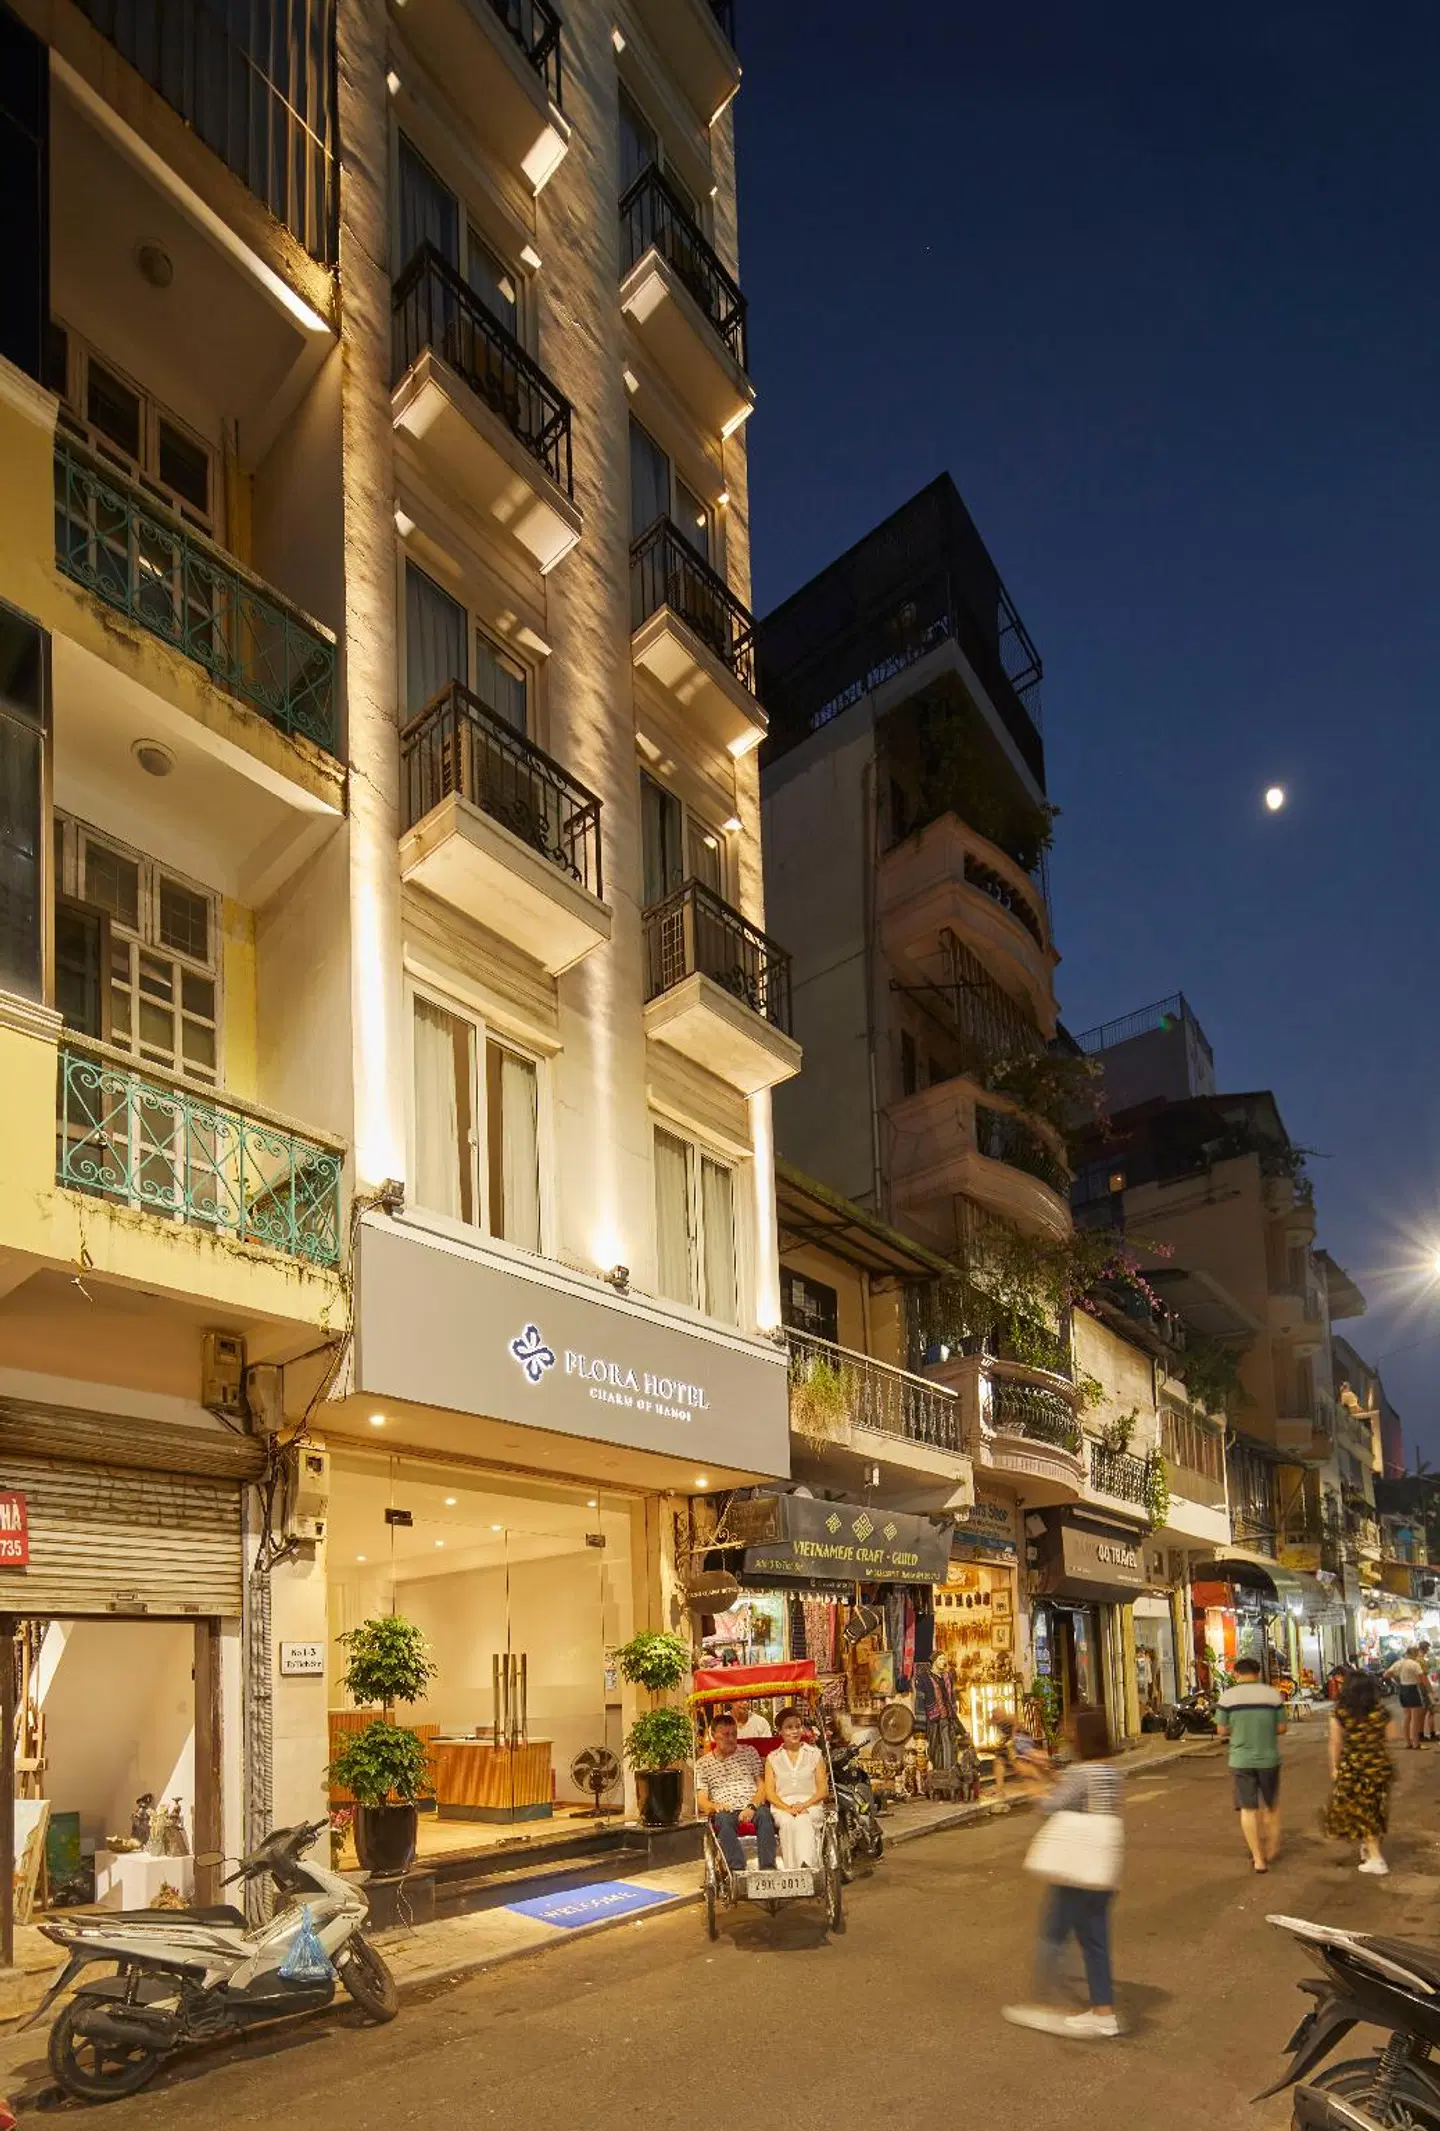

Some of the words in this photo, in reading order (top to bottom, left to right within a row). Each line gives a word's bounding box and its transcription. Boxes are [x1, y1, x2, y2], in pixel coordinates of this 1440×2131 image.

[564, 1350, 640, 1392] FLORA
[643, 1371, 711, 1410] HOTEL
[589, 1387, 633, 1407] CHARM
[636, 1399, 653, 1412] OF
[655, 1403, 692, 1422] HANOI
[0, 1497, 22, 1531] HÀ
[792, 1541, 854, 1561] VIETNAMESE
[856, 1547, 884, 1564] CRAFT
[891, 1551, 919, 1566] GUILD
